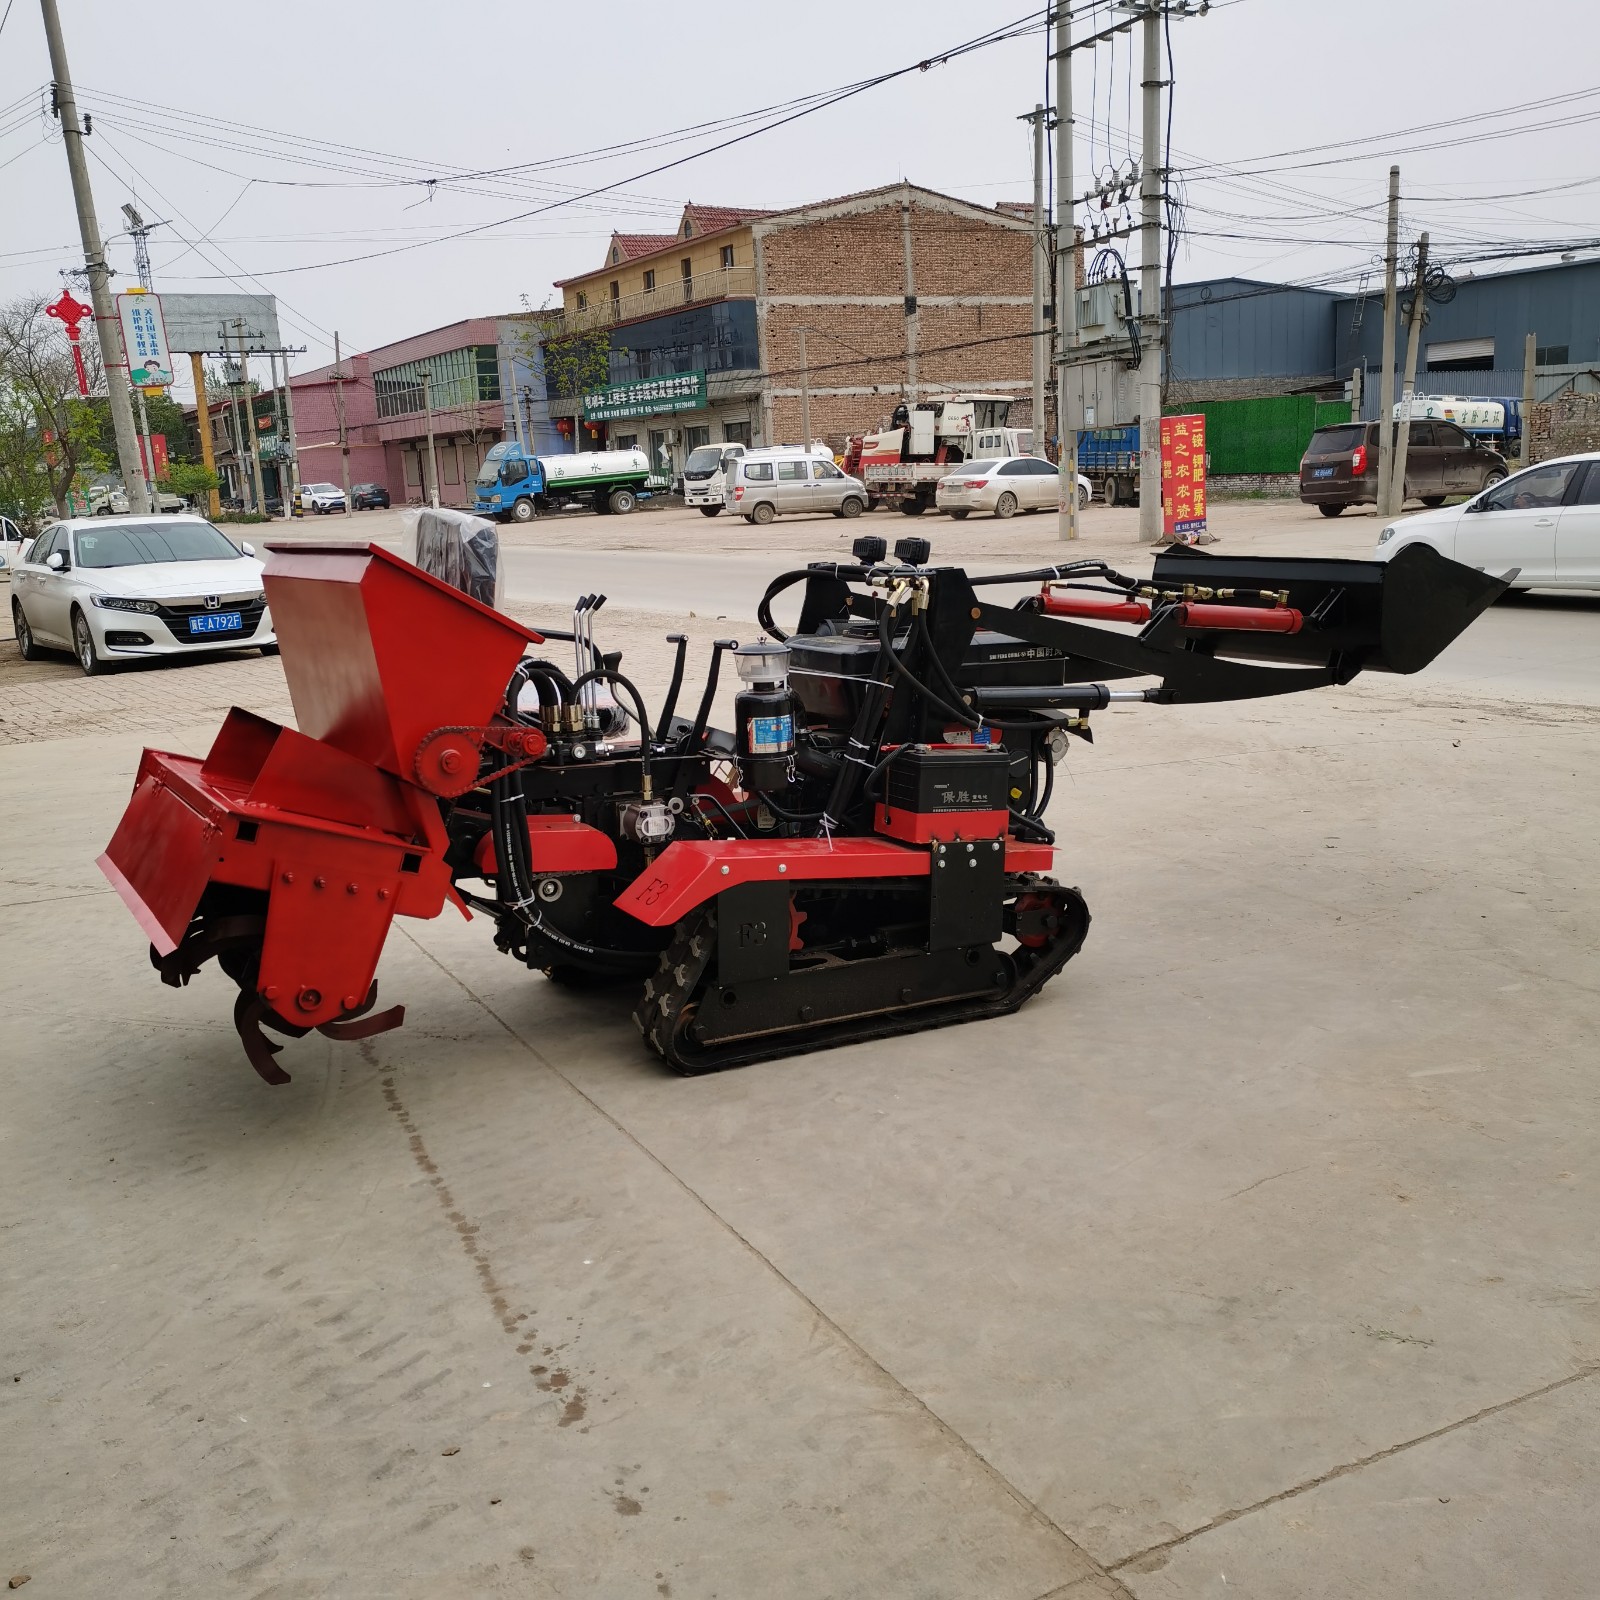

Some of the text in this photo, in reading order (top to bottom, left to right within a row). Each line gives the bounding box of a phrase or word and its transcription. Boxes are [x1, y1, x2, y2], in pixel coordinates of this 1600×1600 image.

[131, 308, 148, 357] 维护少年权益
[144, 308, 160, 356] 关注国家未来
[1164, 497, 1173, 516] 尿素
[1193, 488, 1205, 517] 尿素
